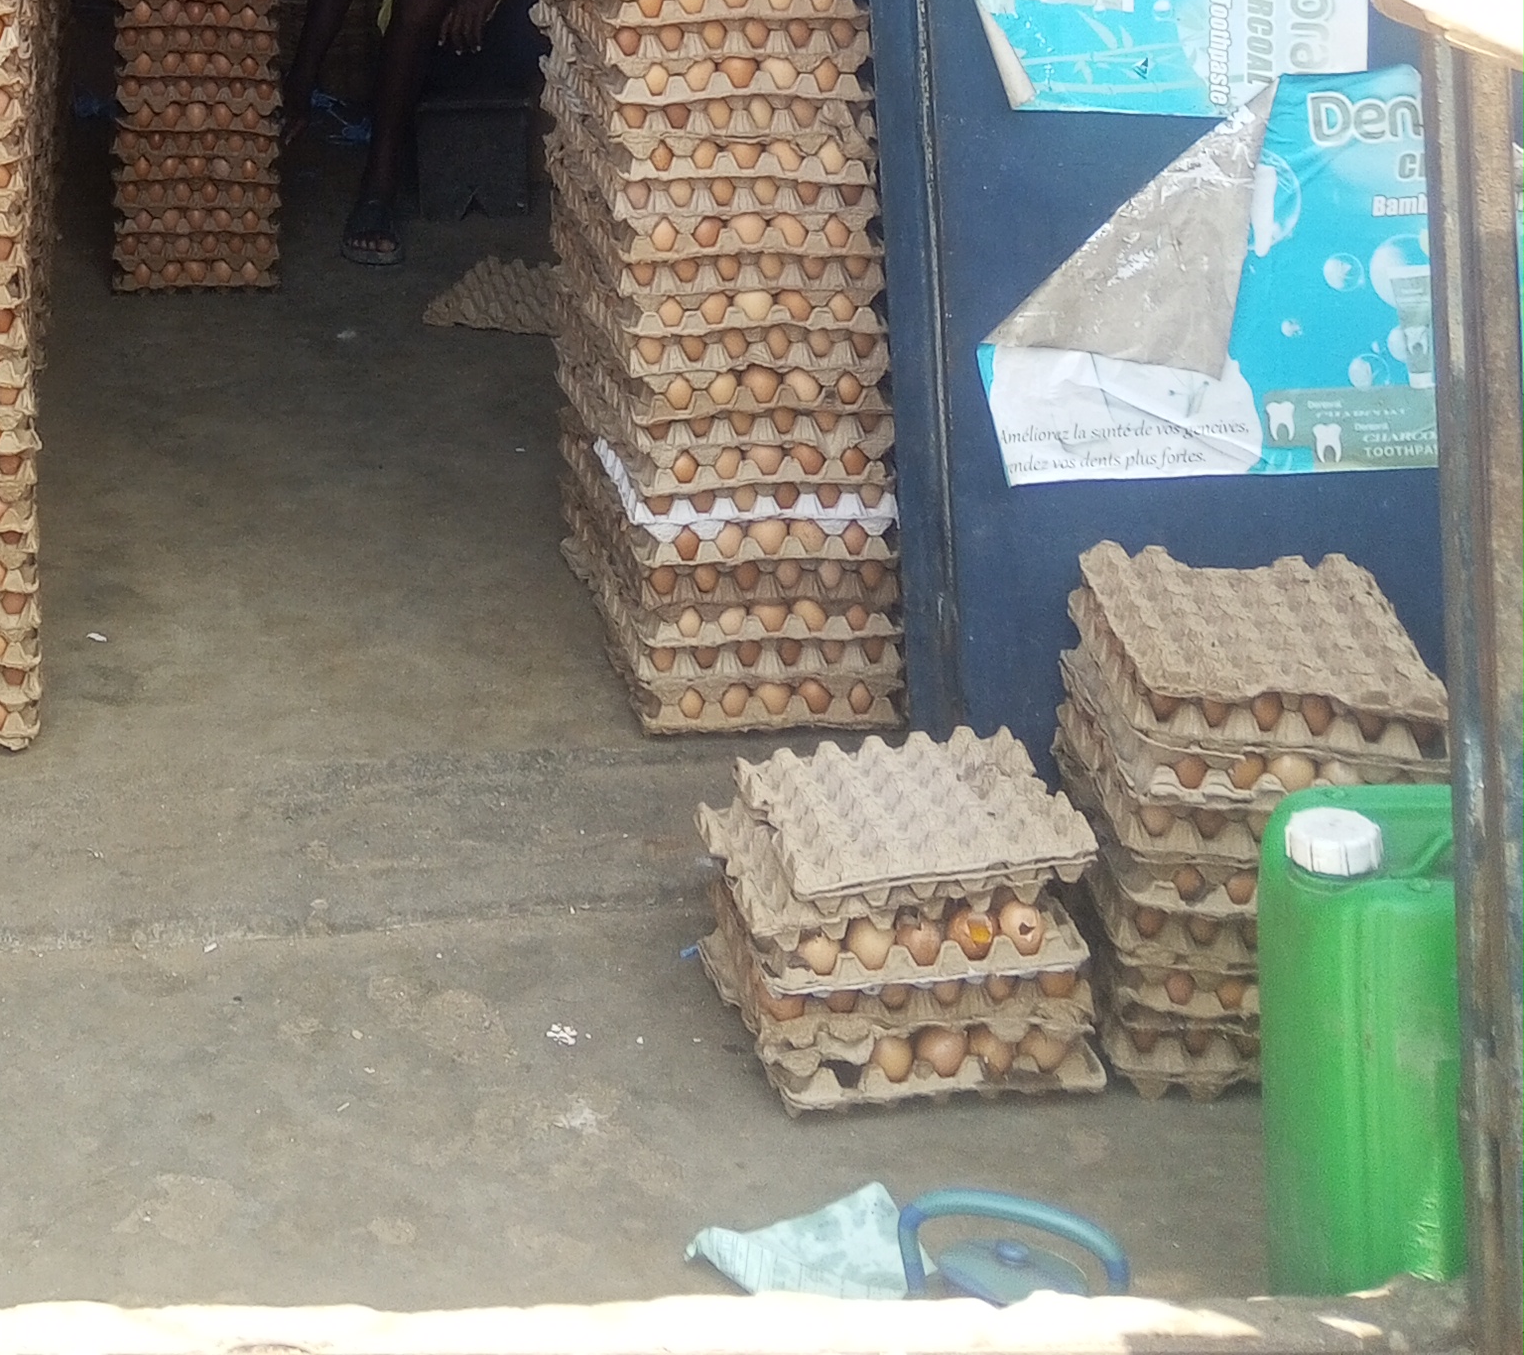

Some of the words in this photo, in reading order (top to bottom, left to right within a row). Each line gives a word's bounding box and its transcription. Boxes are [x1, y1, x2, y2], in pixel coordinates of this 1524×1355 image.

[1371, 193, 1429, 218] Bamb
[1073, 423, 1087, 441] la
[1090, 424, 1131, 440] santé
[1132, 421, 1154, 437] de
[1156, 423, 1181, 436] vos
[1363, 431, 1437, 443] CHARCO
[1007, 455, 1049, 474] endez
[1052, 457, 1076, 471] vos
[1079, 450, 1122, 469] dents
[1124, 447, 1158, 472] plus
[1158, 445, 1207, 474] fortes.
[1363, 444, 1438, 458] TOOTHPA
